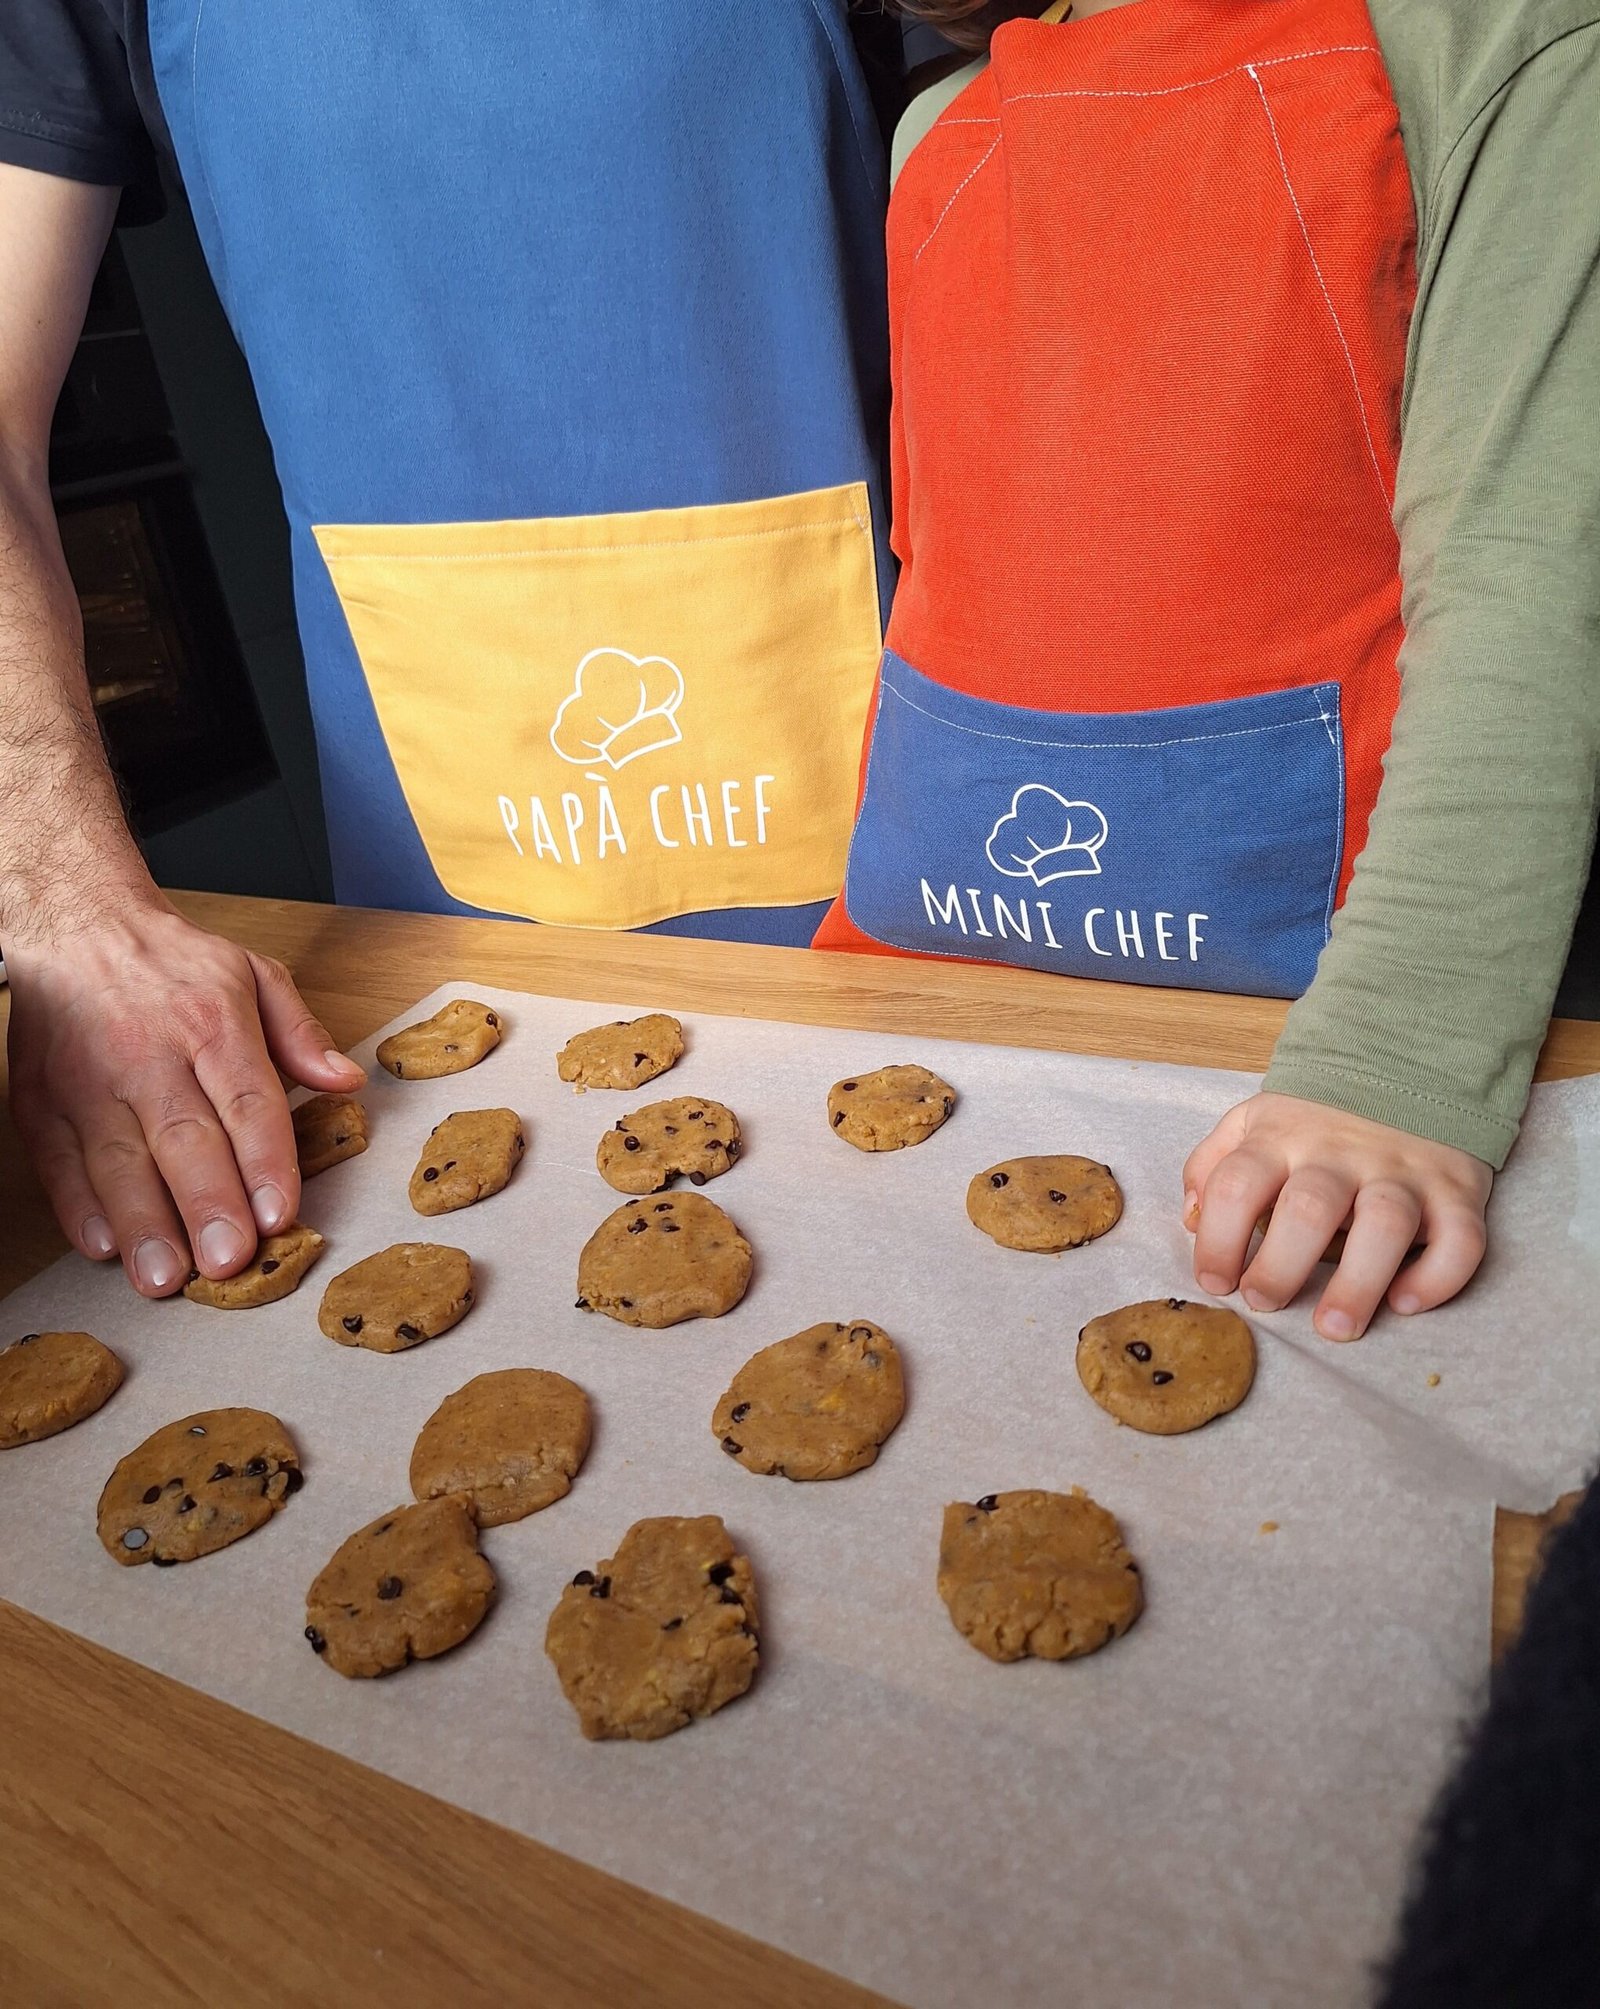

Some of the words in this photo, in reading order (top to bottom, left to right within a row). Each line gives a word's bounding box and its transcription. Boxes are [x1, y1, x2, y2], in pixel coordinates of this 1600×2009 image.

[497, 771, 628, 865] PAPÀ
[648, 774, 776, 848] CHEF
[920, 877, 1063, 949] MINI
[1084, 907, 1210, 962] CHEF
